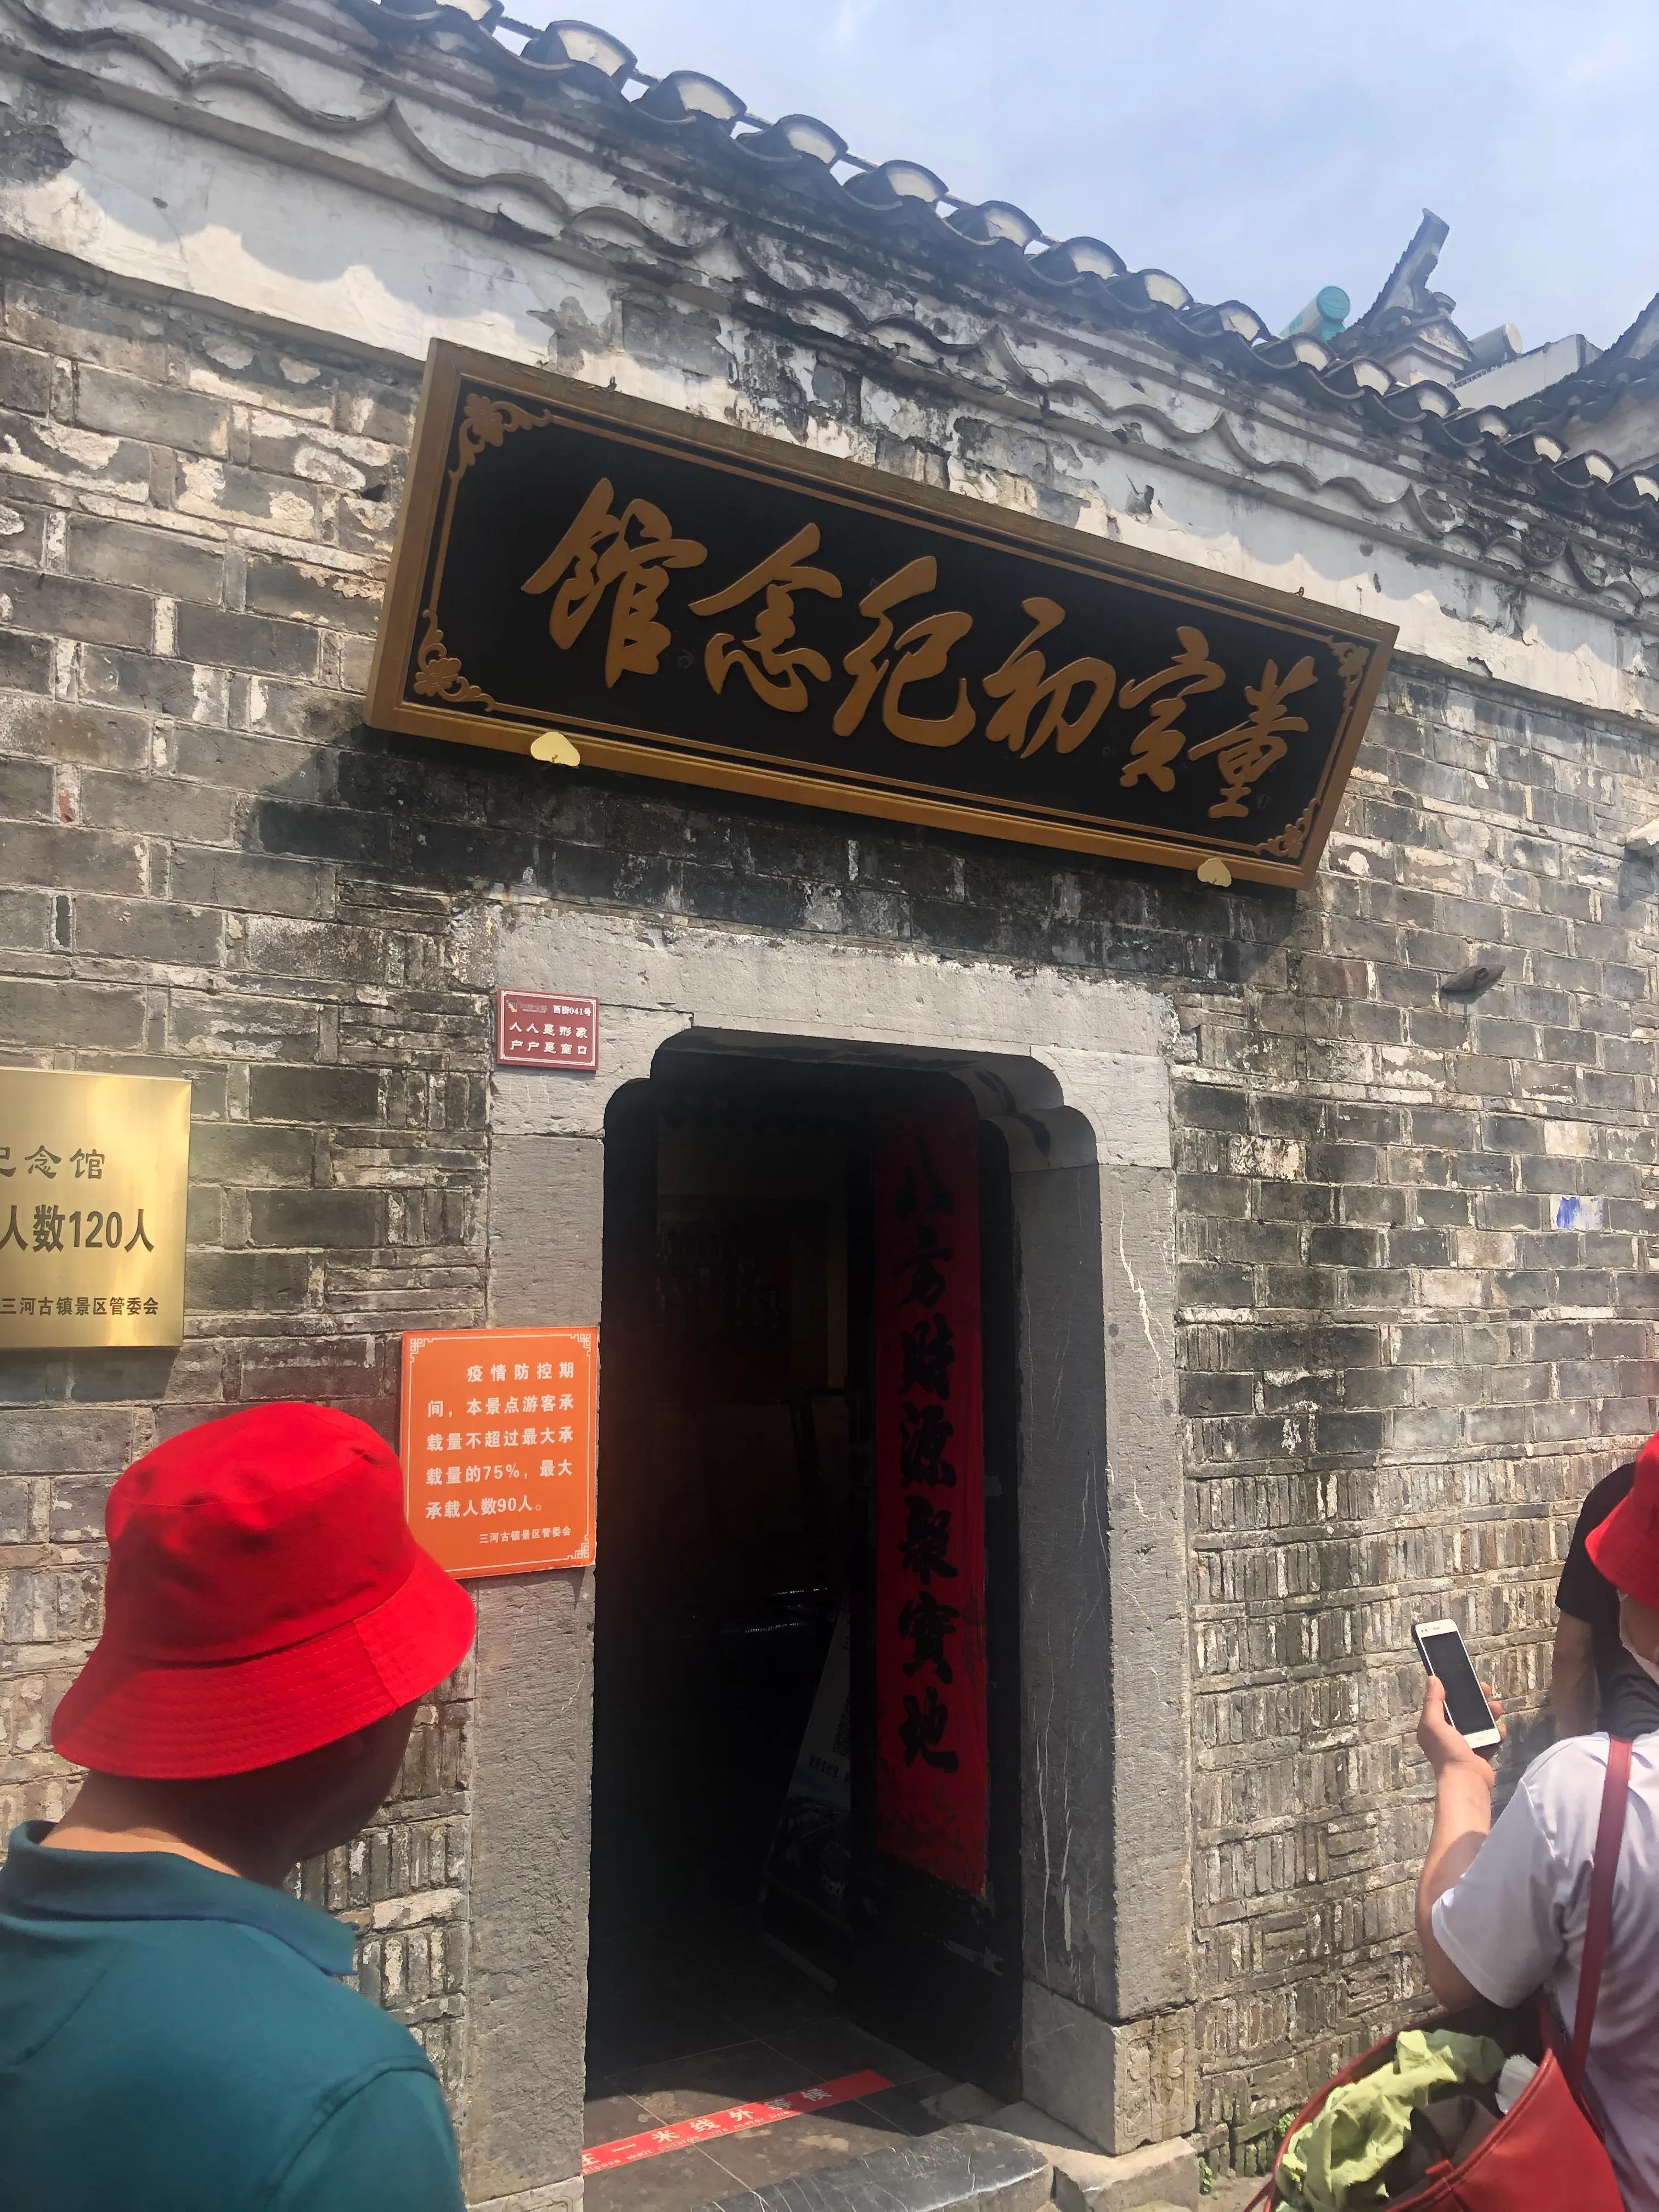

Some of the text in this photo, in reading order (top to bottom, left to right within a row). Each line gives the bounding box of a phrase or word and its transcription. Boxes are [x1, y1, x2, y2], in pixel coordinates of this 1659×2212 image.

[553, 1005, 591, 1017] 西街041号
[509, 1022, 588, 1039] 人人是形象
[510, 1040, 588, 1055] 户户是窗口
[0, 1204, 155, 1253] 人数120人
[1, 1296, 159, 1316] 三河古镇景区管委会
[466, 1361, 575, 1383] 疫情防控期
[426, 1426, 574, 1452] 载量不超过最大承
[479, 1526, 572, 1544] 三河古镇景区管委会
[625, 2149, 653, 2160] wait
[708, 2127, 729, 2137] one
[733, 2116, 765, 2130] meter
[769, 2110, 790, 2120] line
